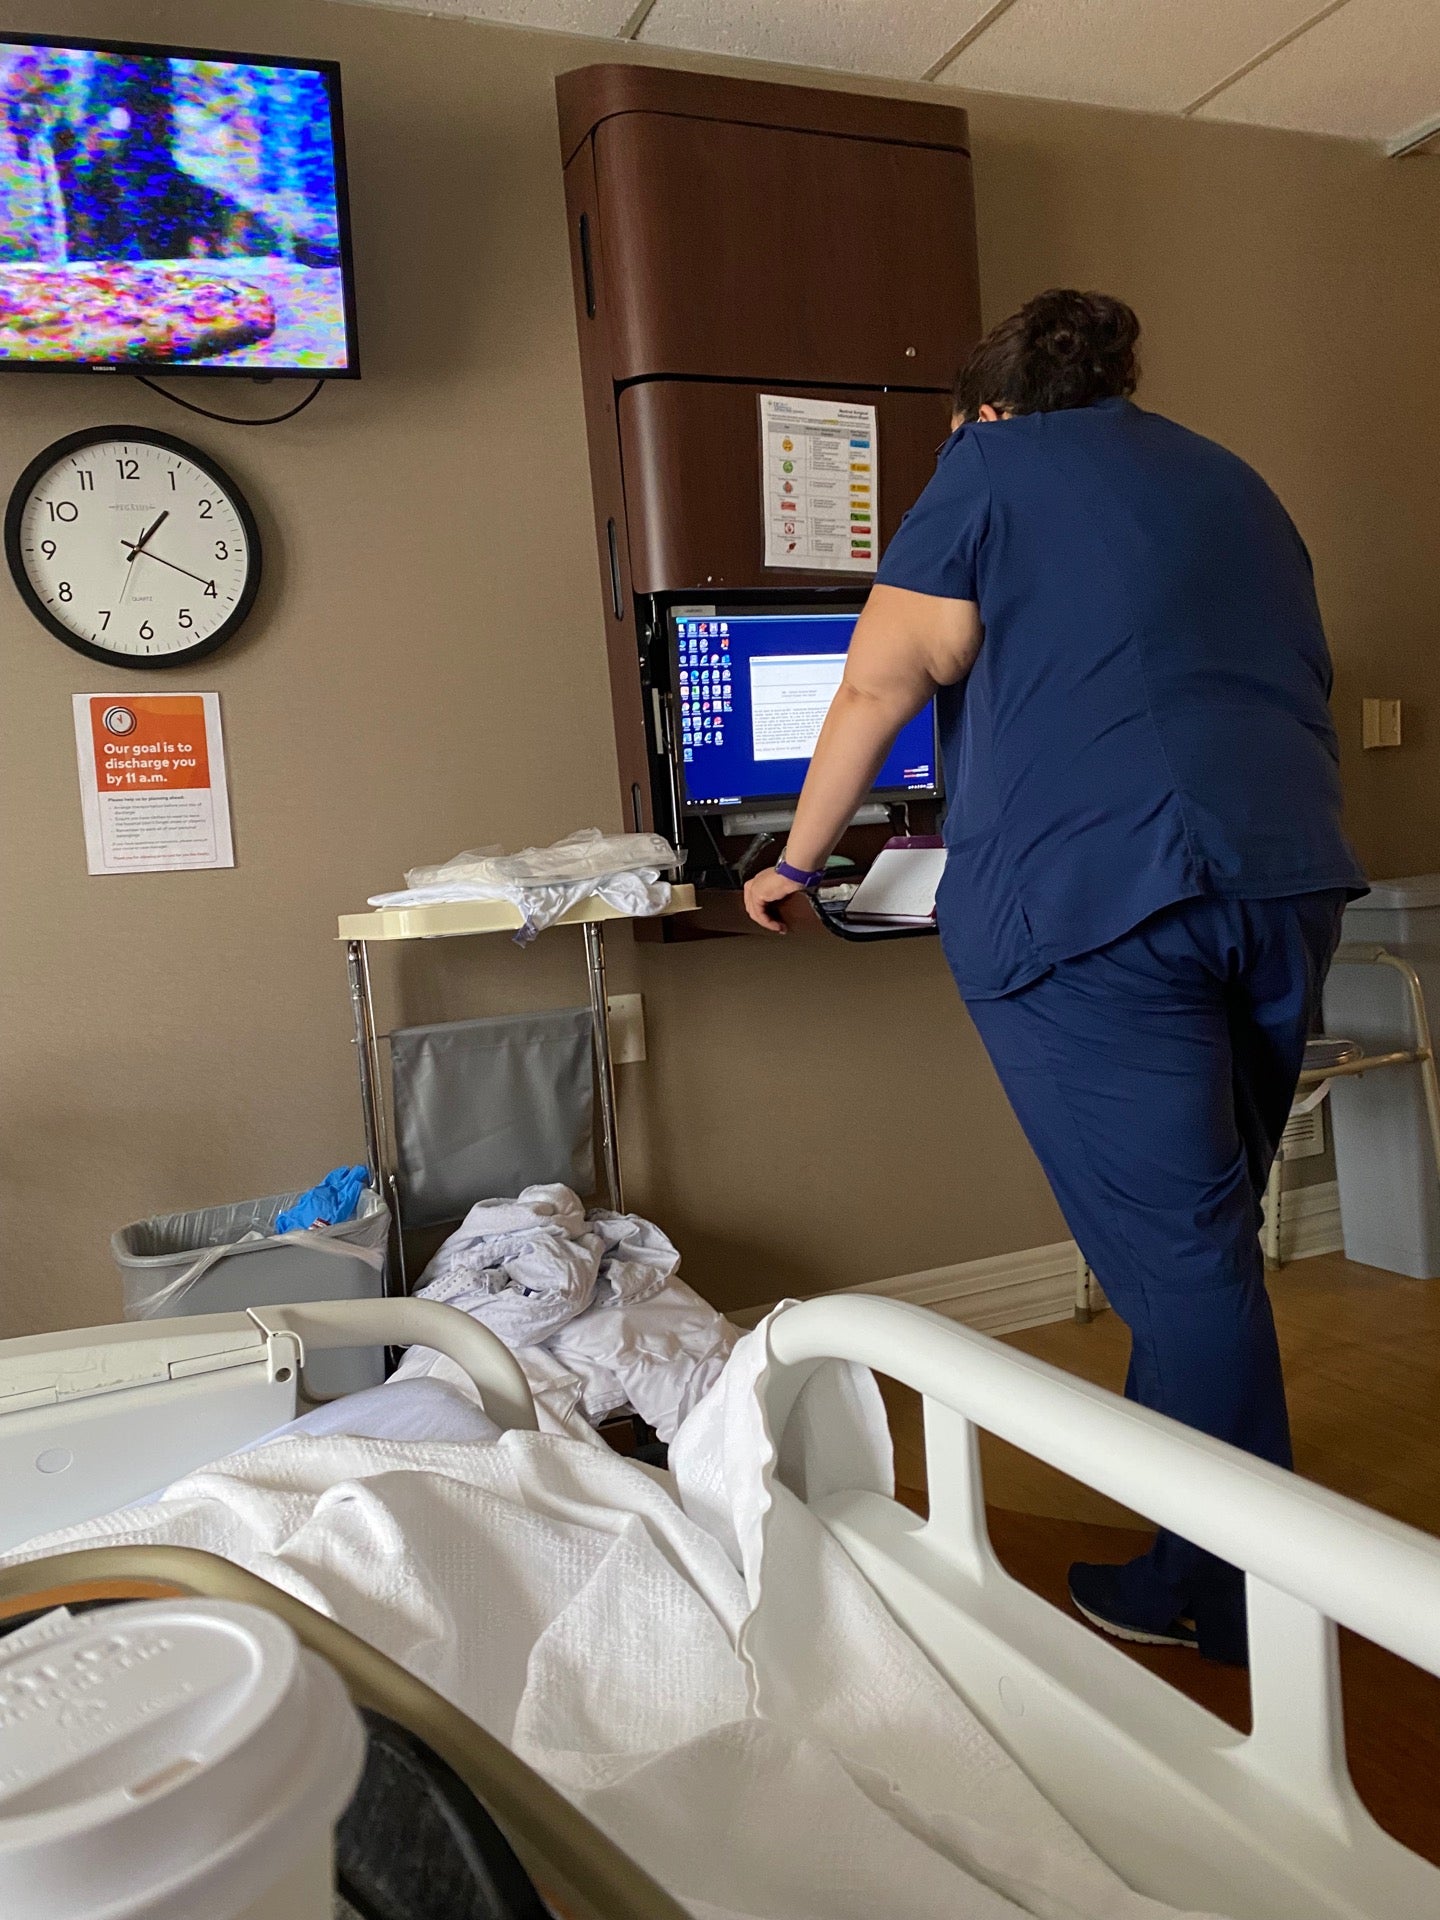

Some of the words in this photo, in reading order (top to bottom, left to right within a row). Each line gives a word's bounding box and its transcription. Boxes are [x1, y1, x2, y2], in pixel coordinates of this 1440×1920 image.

[115, 459, 141, 480] 12
[76, 470, 95, 491] 11
[167, 471, 177, 491] 1
[46, 501, 79, 522] 10
[198, 499, 213, 519] 2
[41, 540, 57, 560] 9
[214, 540, 229, 560] 3
[58, 581, 73, 602] 8
[203, 579, 218, 599] 4
[98, 611, 111, 630] 7
[178, 609, 193, 628] 5
[139, 620, 154, 640] 6
[103, 743, 130, 754] Our
[132, 742, 160, 756] goal
[163, 741, 175, 753] is
[177, 742, 193, 752] to
[105, 758, 170, 770] discharge
[172, 758, 196, 770] you
[106, 773, 123, 786] by
[125, 772, 136, 783] 11
[139, 773, 168, 783] a.m.
